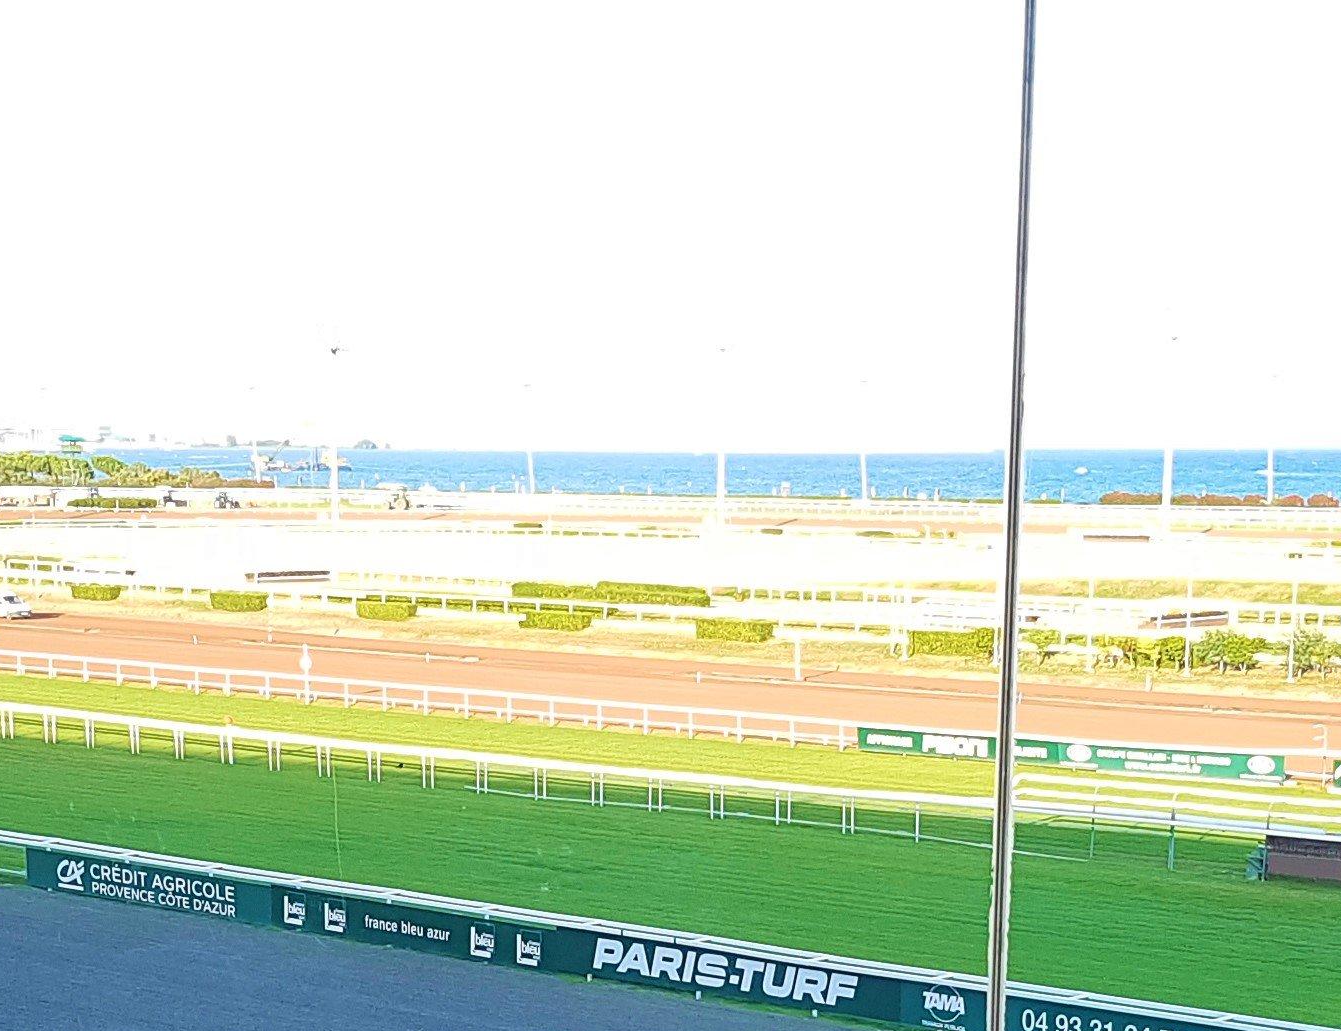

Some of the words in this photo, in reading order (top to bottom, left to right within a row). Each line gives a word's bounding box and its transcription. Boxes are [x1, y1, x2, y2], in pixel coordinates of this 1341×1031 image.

[89, 863, 148, 888] CRÉDIT
[151, 873, 235, 903] AGRICOLE
[91, 882, 156, 904] PROVENCE
[158, 891, 190, 909] CÔTE
[193, 898, 237, 918] D'AZUR
[364, 914, 398, 933] france
[401, 919, 425, 937] bleu
[426, 927, 451, 942] azur
[592, 937, 859, 1006] PARIS-TURF
[922, 990, 966, 1016] TAMA
